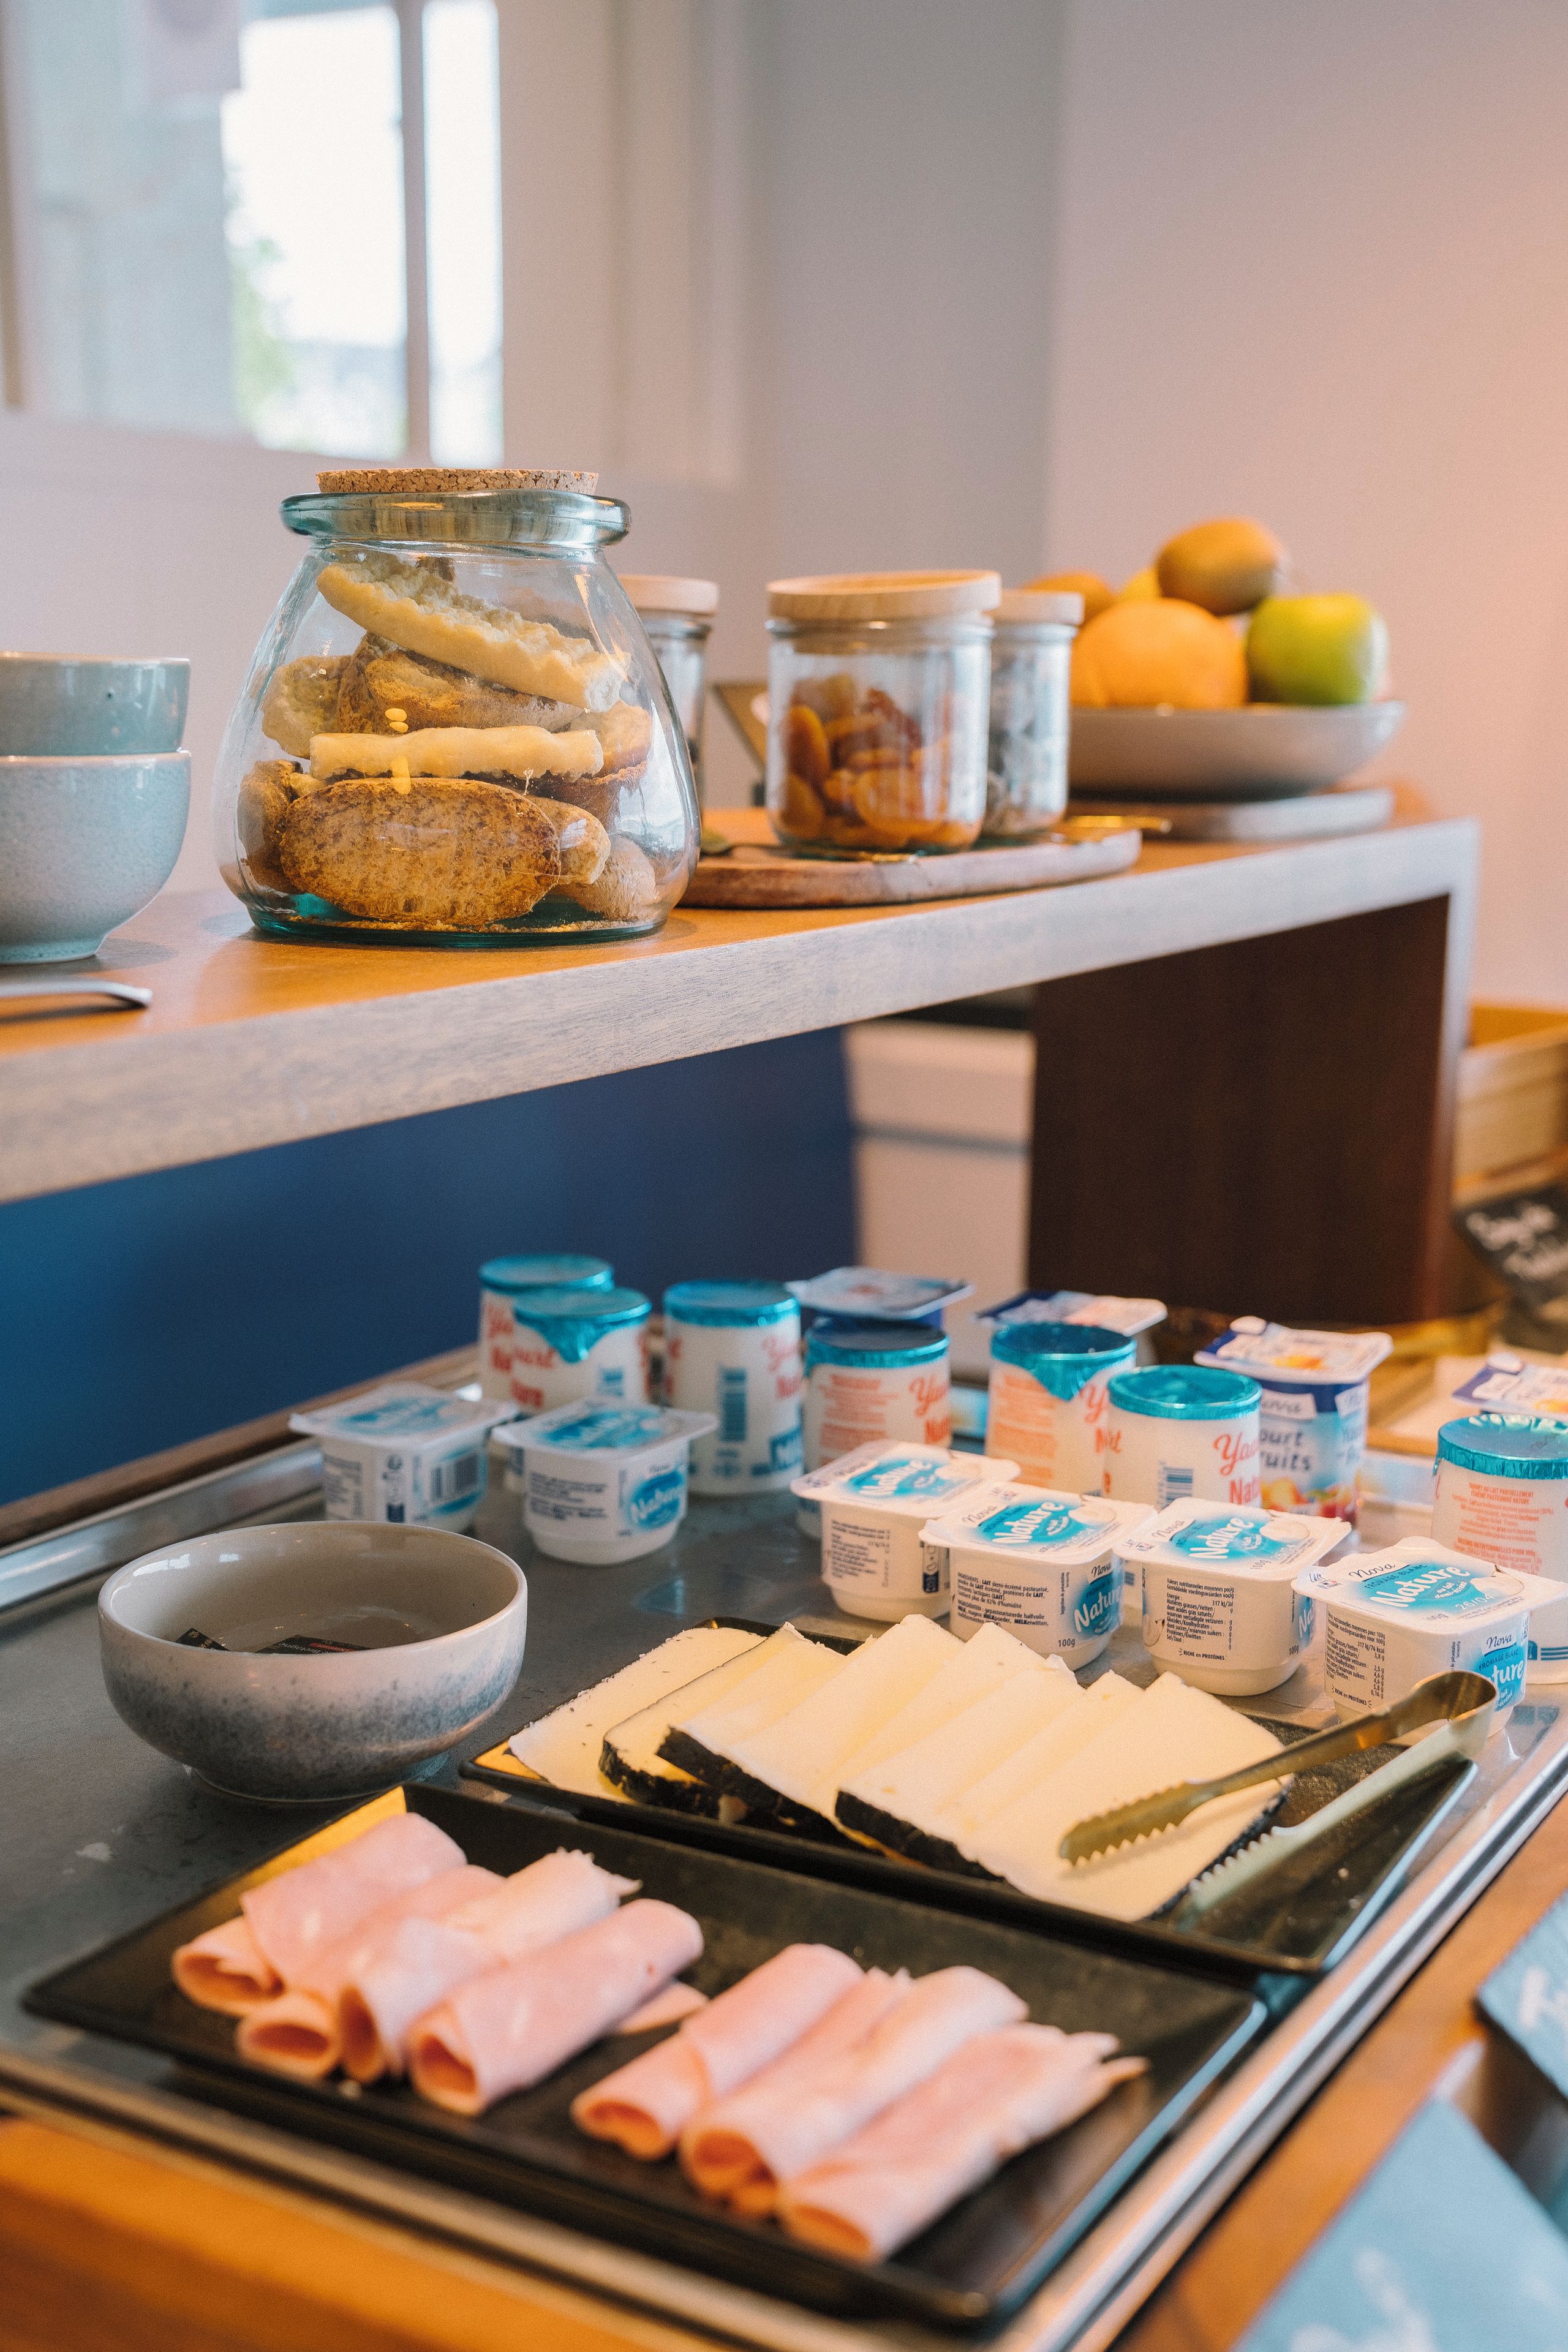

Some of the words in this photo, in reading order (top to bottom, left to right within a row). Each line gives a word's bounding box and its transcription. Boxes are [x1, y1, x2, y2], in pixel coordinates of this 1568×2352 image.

[992, 1502, 1066, 1544] Nature
[1188, 1518, 1255, 1559] Nature
[1091, 1562, 1112, 1578] Nova
[1349, 1564, 1396, 1578] Nova
[992, 1581, 1022, 1591] demi-écrémé
[1003, 1589, 1024, 1597] protéines
[1188, 1589, 1222, 1597] voedingswaarden
[1370, 1567, 1471, 1607] Nature
[997, 1600, 1022, 1609] d'humidité
[1455, 1593, 1495, 1610] 26/04
[1058, 1638, 1076, 1648] 100g
[1376, 1638, 1385, 1646] 100g
[1486, 1634, 1512, 1649] Nova
[1289, 1645, 1299, 1656] 100g
[1479, 1653, 1504, 1672] FROMAGE
[1505, 1649, 1519, 1659] BLANC
[1491, 1660, 1524, 1685] ture
